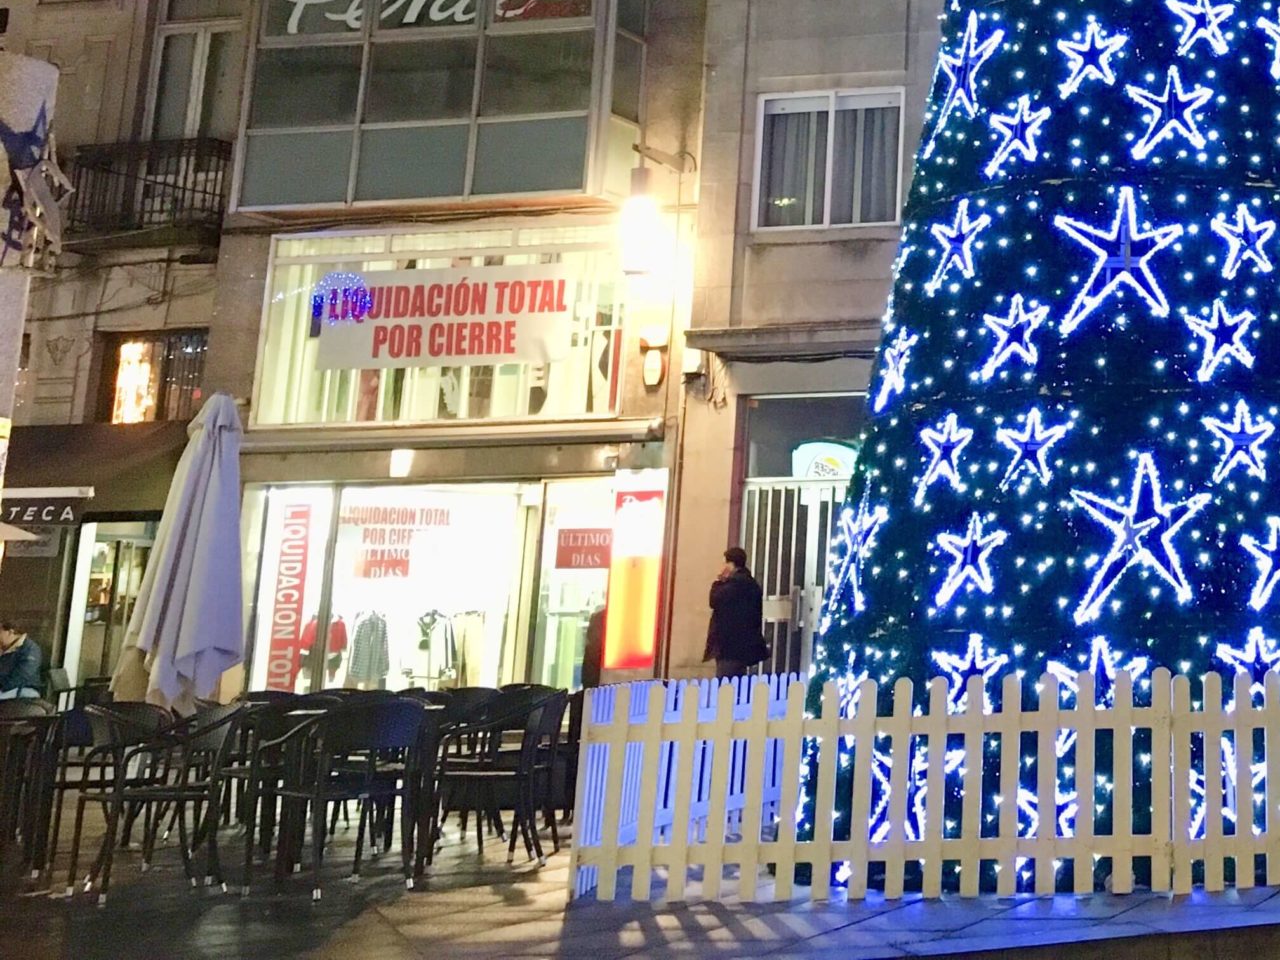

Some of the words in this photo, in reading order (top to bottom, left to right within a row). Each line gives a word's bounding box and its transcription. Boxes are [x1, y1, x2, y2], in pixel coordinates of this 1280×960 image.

[328, 277, 488, 323] LIQUIDACIÓN
[494, 279, 567, 315] TOTAL
[371, 324, 423, 359] POR
[428, 321, 516, 357] CIERRE
[9, 505, 75, 521] TECA
[419, 508, 450, 526] TOTAL
[361, 528, 386, 545] POR
[560, 529, 614, 548] ÚLTIMO
[571, 550, 601, 566] DÍAS
[266, 646, 294, 691] TOT
